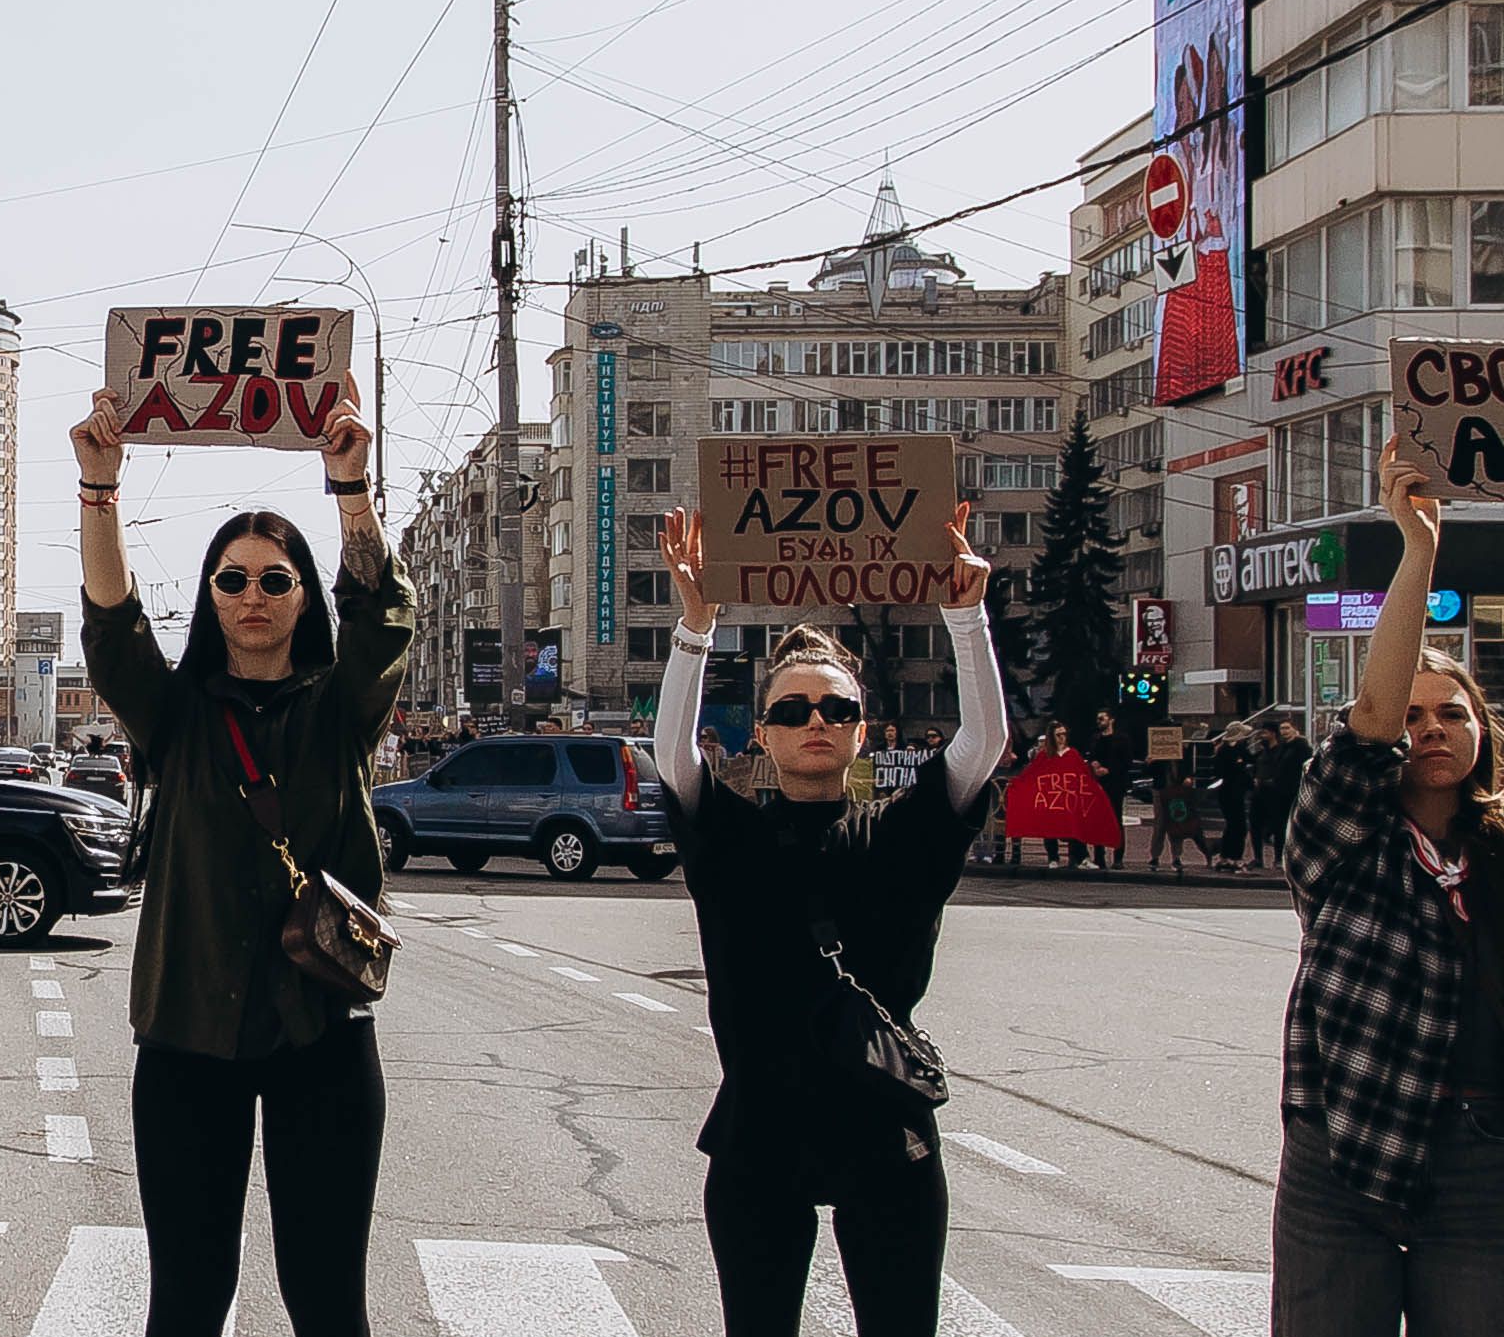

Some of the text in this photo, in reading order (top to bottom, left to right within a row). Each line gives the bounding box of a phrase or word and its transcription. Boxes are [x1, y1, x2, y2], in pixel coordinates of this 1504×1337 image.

[138, 316, 321, 380] FREE
[1272, 347, 1326, 402] KFC
[120, 374, 340, 438] AZOV
[720, 444, 902, 489] #FREE
[601, 354, 611, 643] ІНСТИТУТ МІСТОБУДУВАННЯ
[734, 488, 920, 534] AZOV
[778, 535, 898, 561] БУДЬ ЇХ
[1241, 538, 1321, 592] аптек
[738, 563, 959, 606] ГОЛОСОМ
[1140, 655, 1169, 663] KFC
[1034, 790, 1096, 817] AZOV
[1037, 772, 1093, 795] FREE
